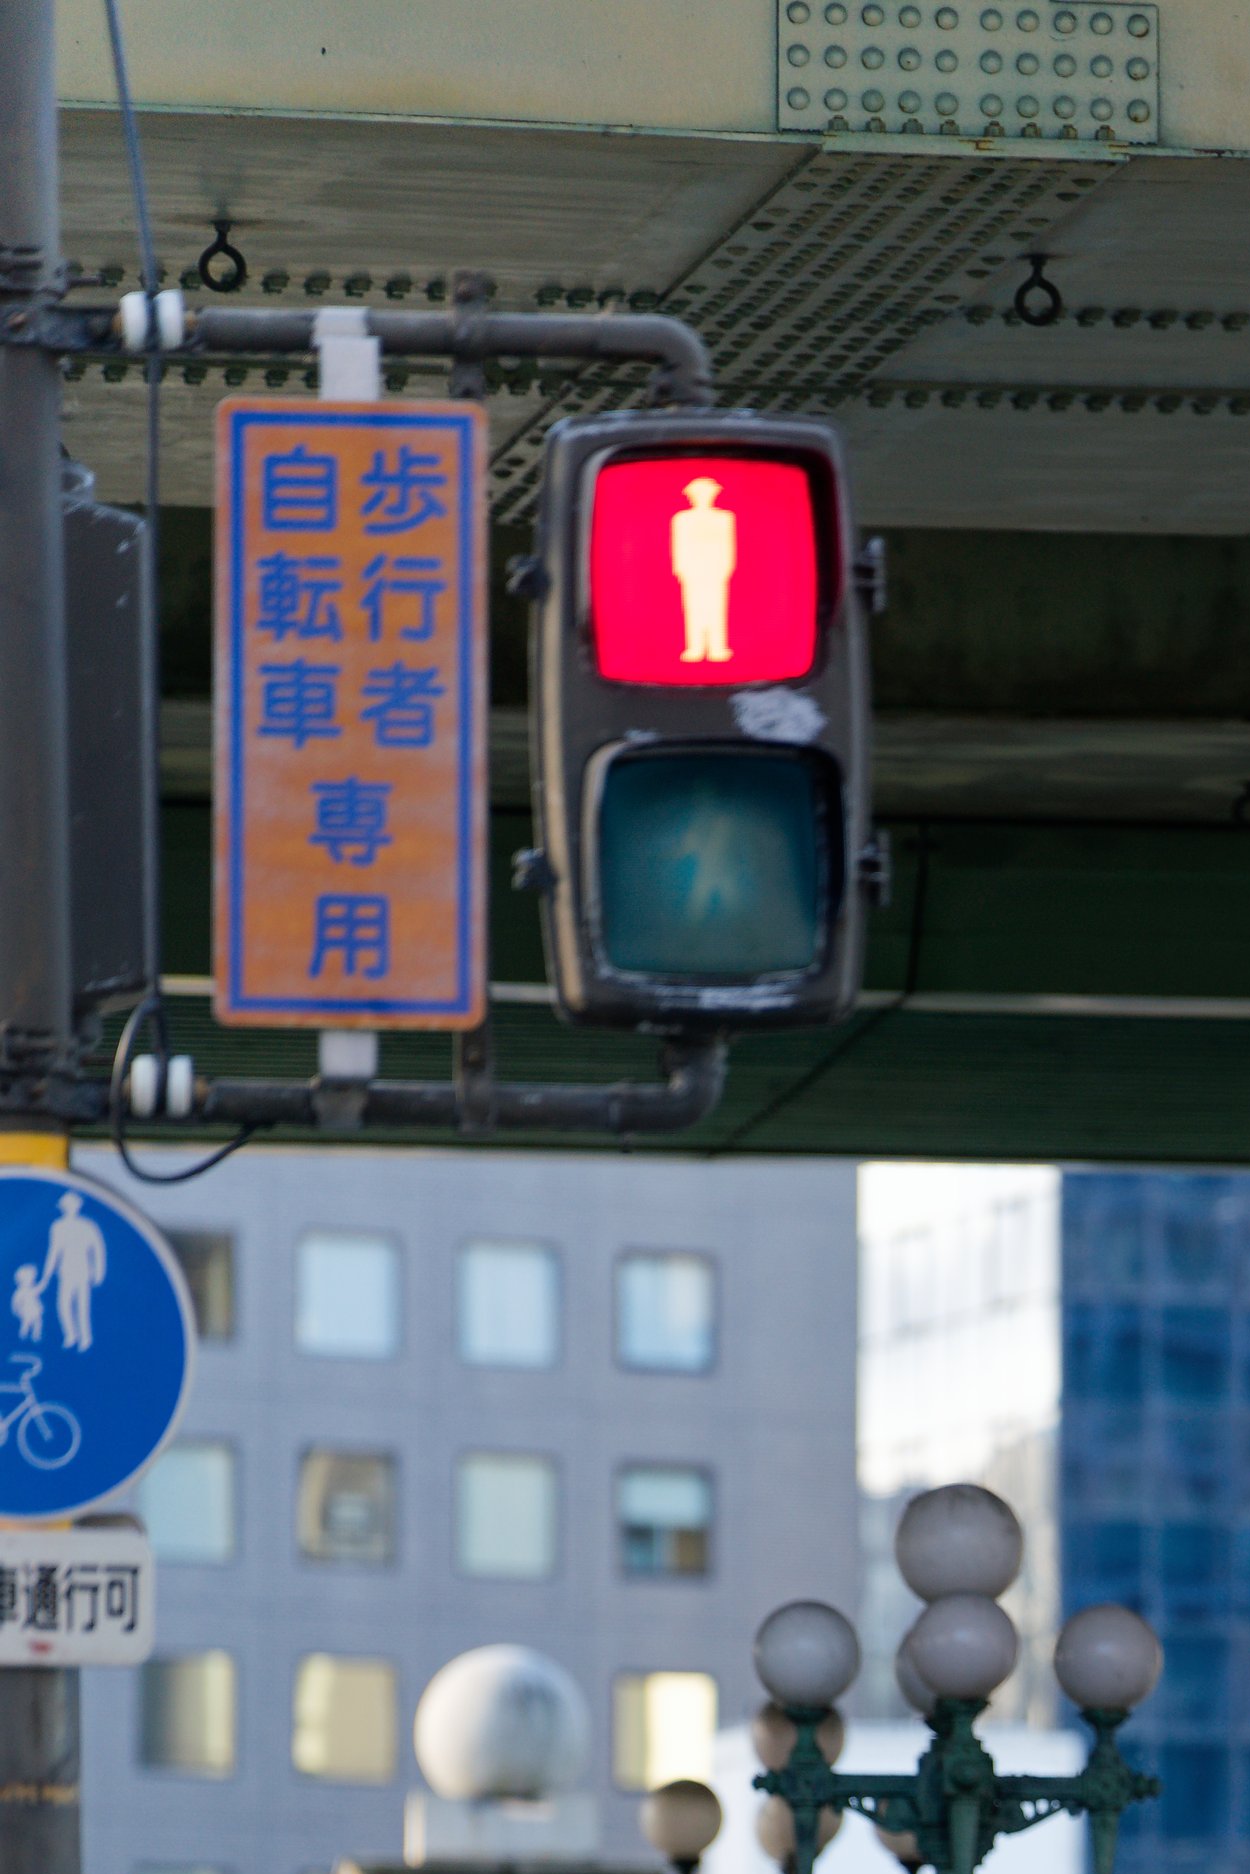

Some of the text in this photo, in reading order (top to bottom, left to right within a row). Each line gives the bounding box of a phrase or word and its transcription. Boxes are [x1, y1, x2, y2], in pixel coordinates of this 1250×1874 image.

[255, 443, 344, 751] 自転車
[358, 443, 448, 749] 歩行者
[306, 775, 395, 980] 専用
